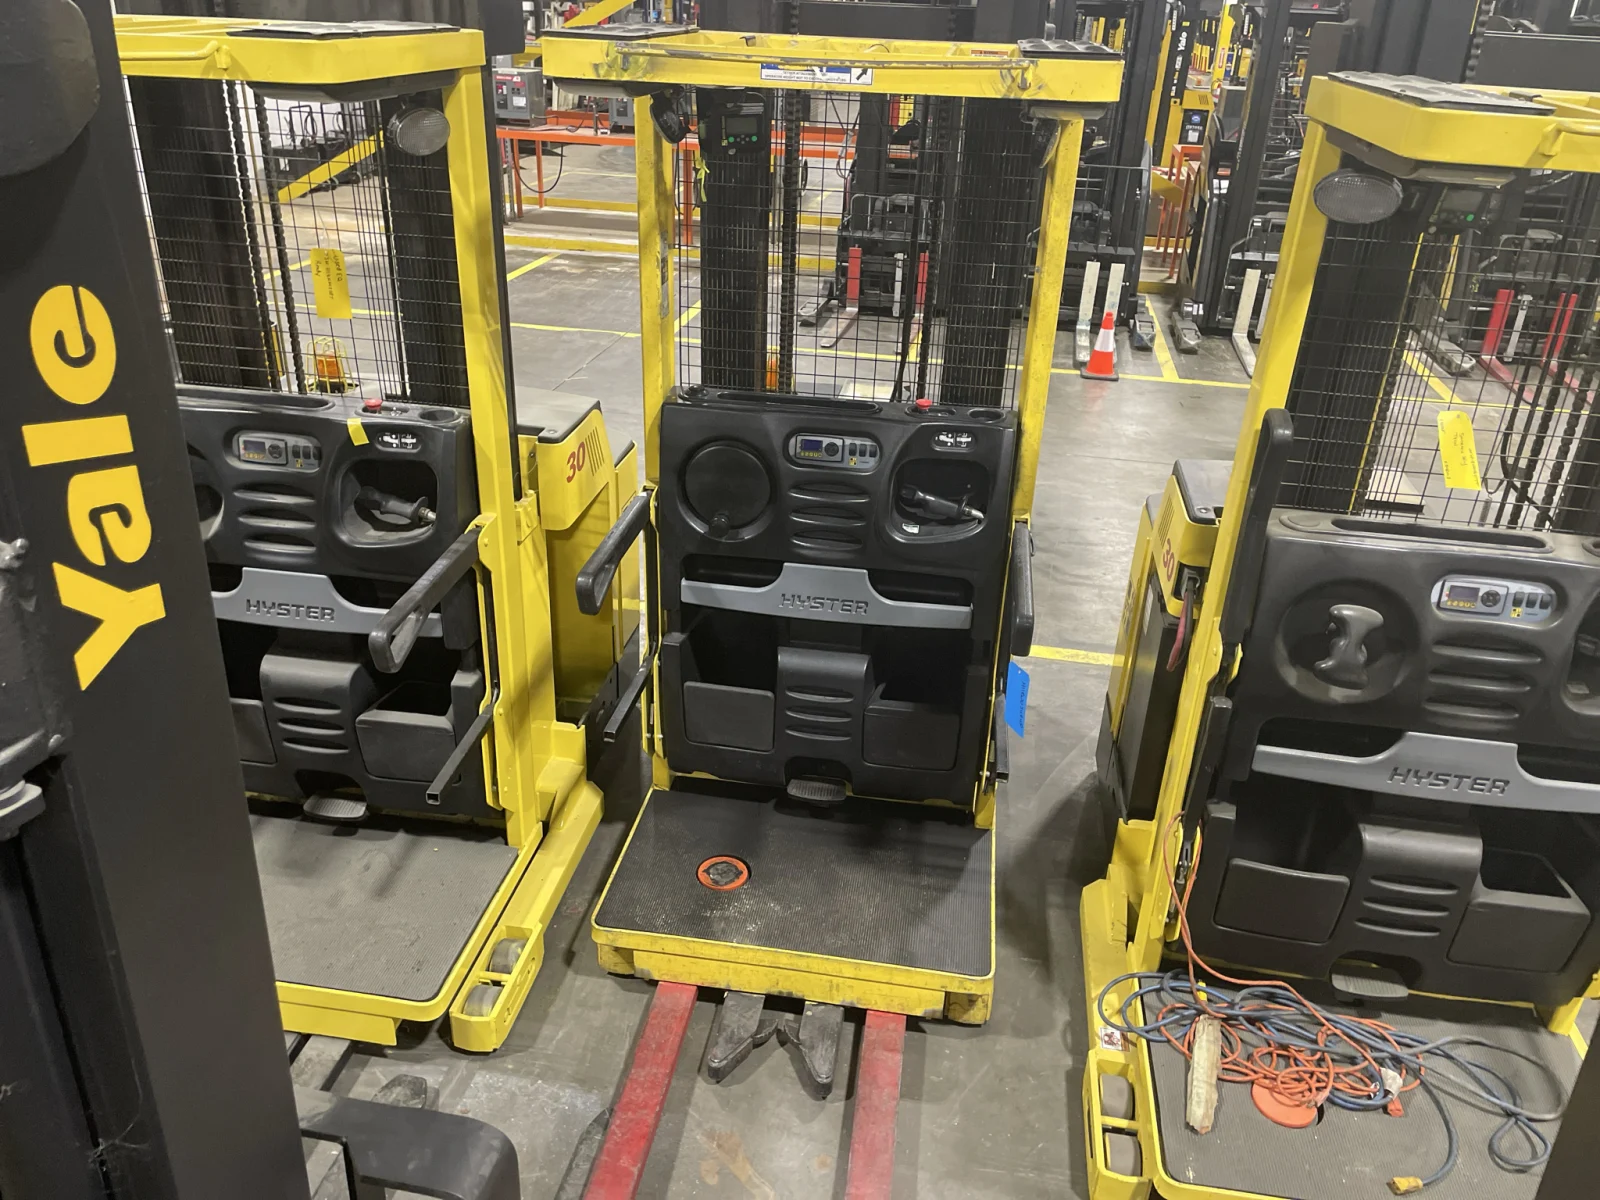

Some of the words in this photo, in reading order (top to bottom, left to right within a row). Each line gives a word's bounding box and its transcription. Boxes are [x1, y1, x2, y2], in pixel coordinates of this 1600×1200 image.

[566, 441, 586, 484] 30
[22, 285, 166, 691] Yale
[1162, 537, 1175, 582] 30
[246, 599, 335, 623] HYSTER
[778, 593, 869, 616] HYSTER
[1386, 766, 1510, 797] HYSTER
